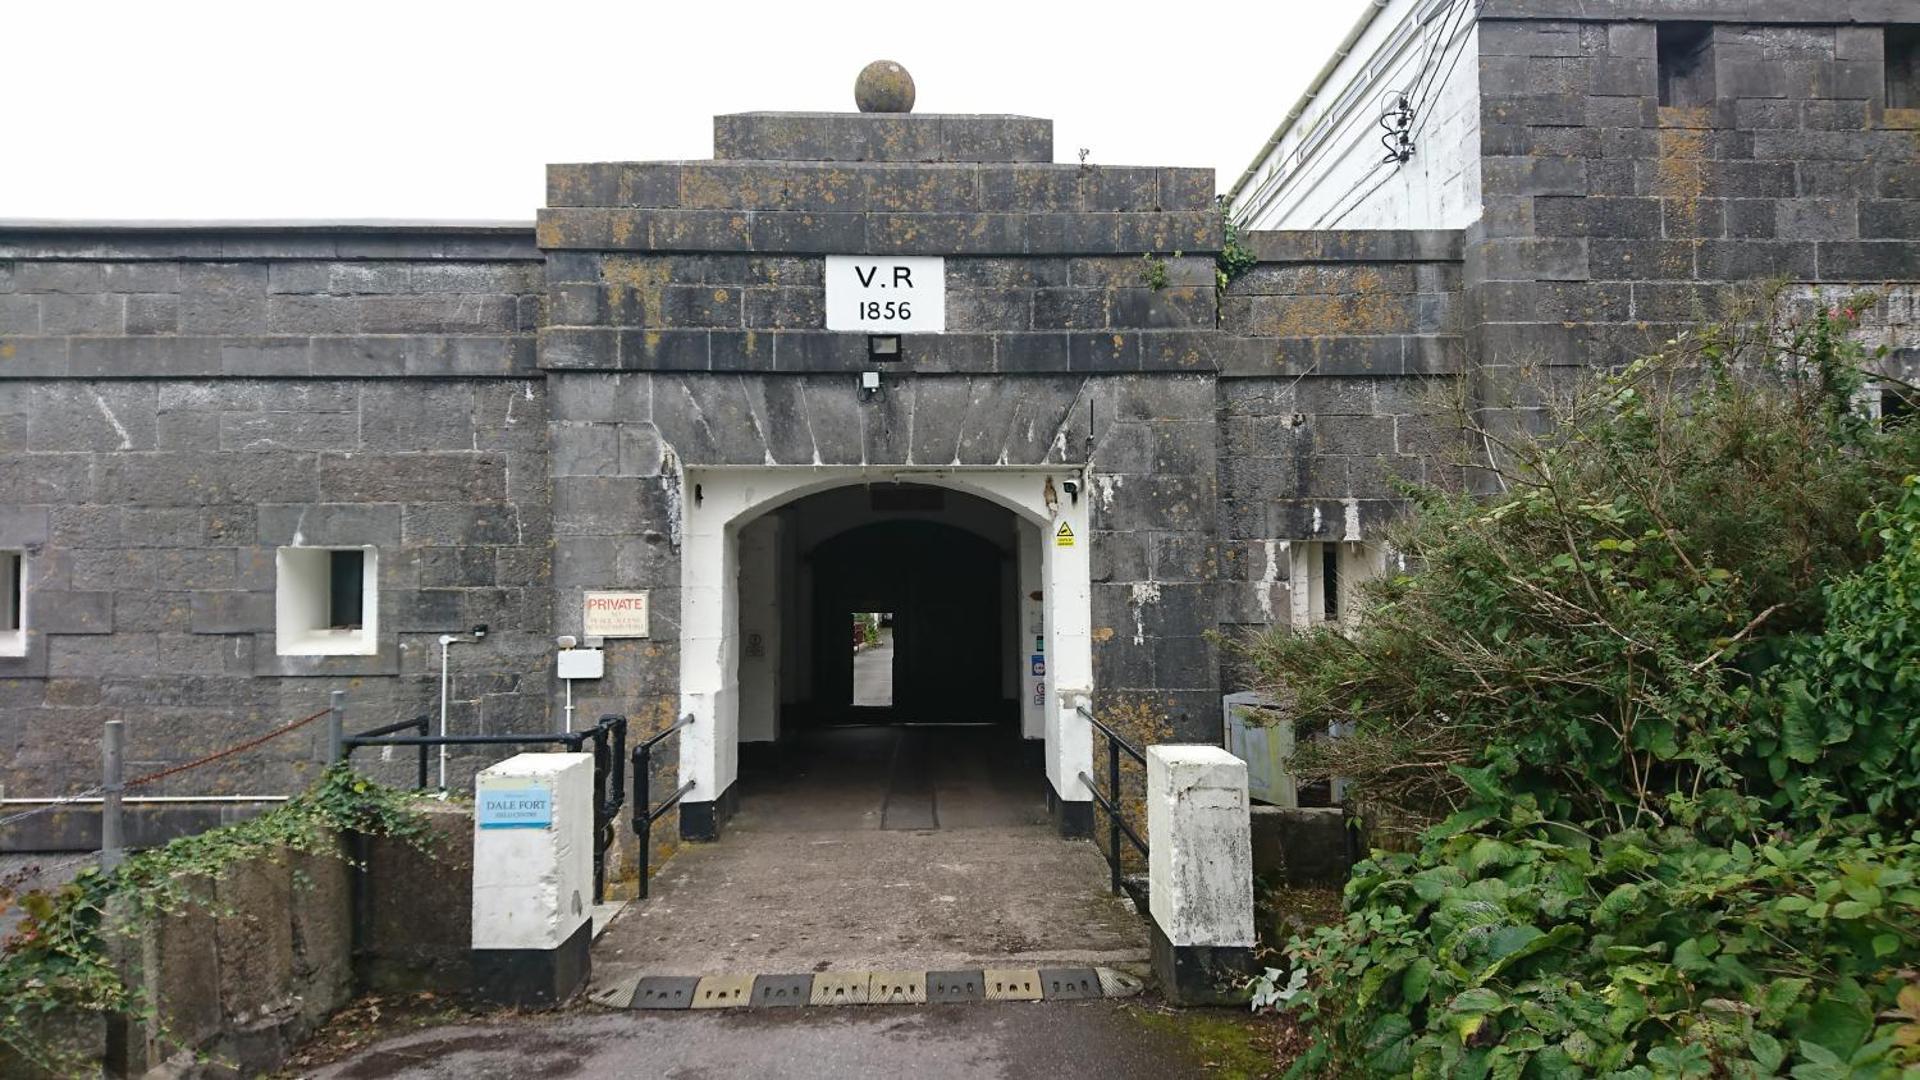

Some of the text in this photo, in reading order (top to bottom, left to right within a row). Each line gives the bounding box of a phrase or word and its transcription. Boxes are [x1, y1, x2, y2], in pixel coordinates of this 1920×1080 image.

[855, 265, 914, 288] V.R
[860, 301, 911, 320] 1856
[588, 598, 643, 610] PRIVATE
[487, 800, 547, 810] DALE FORT
